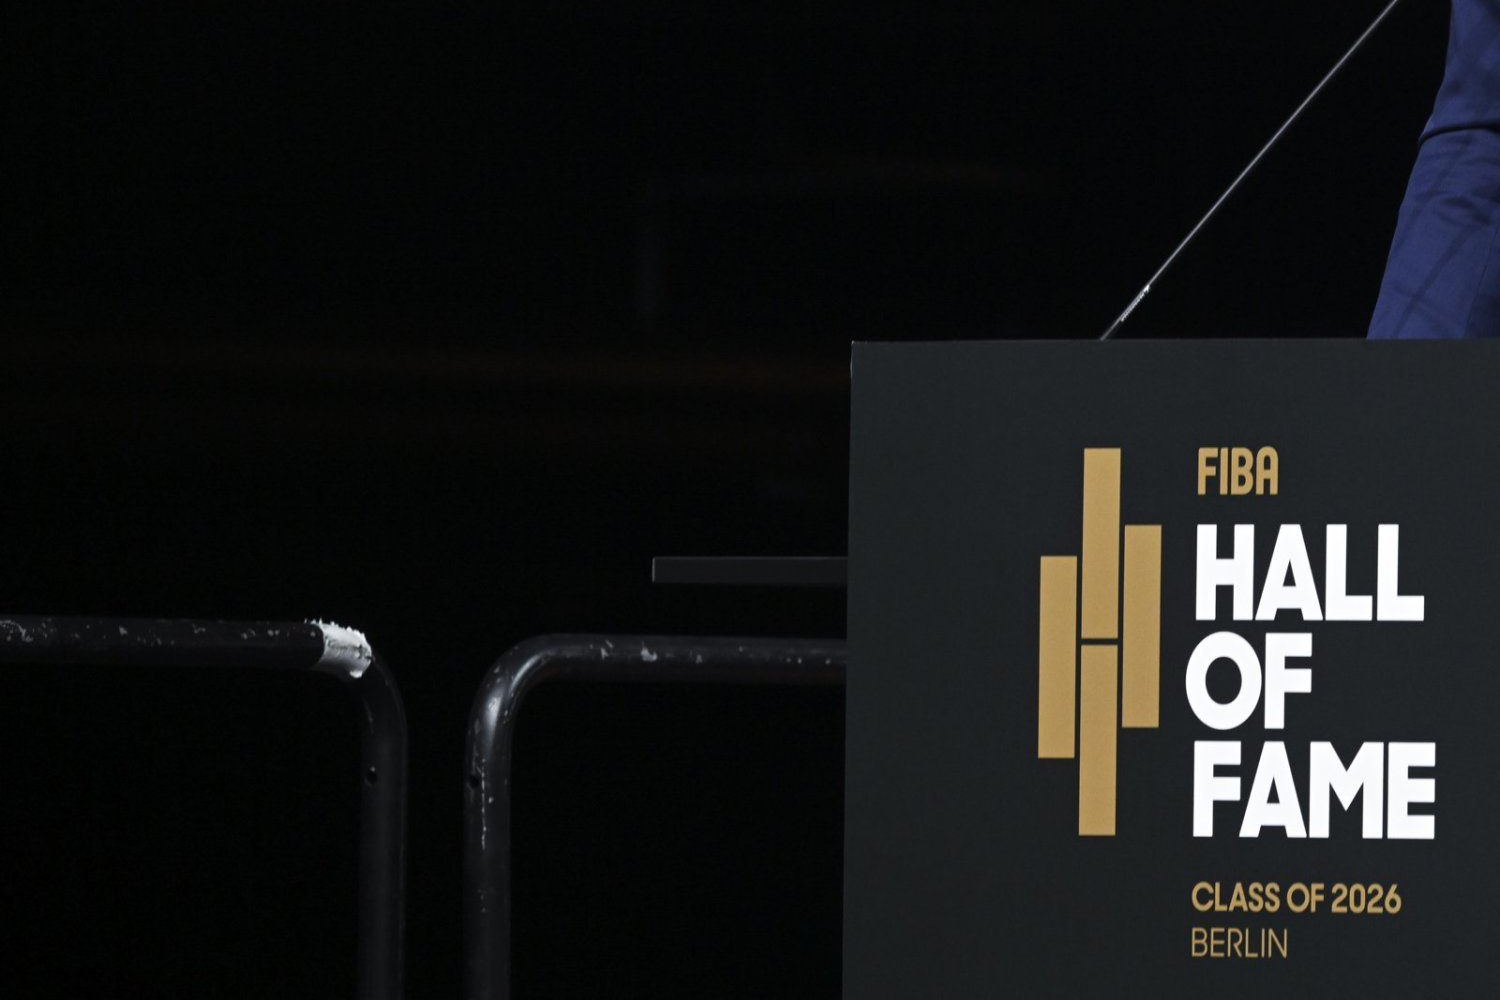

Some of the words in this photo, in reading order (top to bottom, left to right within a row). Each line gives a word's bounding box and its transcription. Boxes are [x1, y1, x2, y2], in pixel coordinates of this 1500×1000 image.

[1198, 446, 1278, 495] FIBA
[1195, 524, 1425, 621] HALL
[1185, 631, 1313, 731] OF
[1193, 740, 1437, 840] FAME
[1191, 881, 1281, 913] CLASS
[1286, 882, 1325, 913] OF
[1331, 882, 1402, 914] 2026
[1191, 928, 1288, 959] BERLIN
